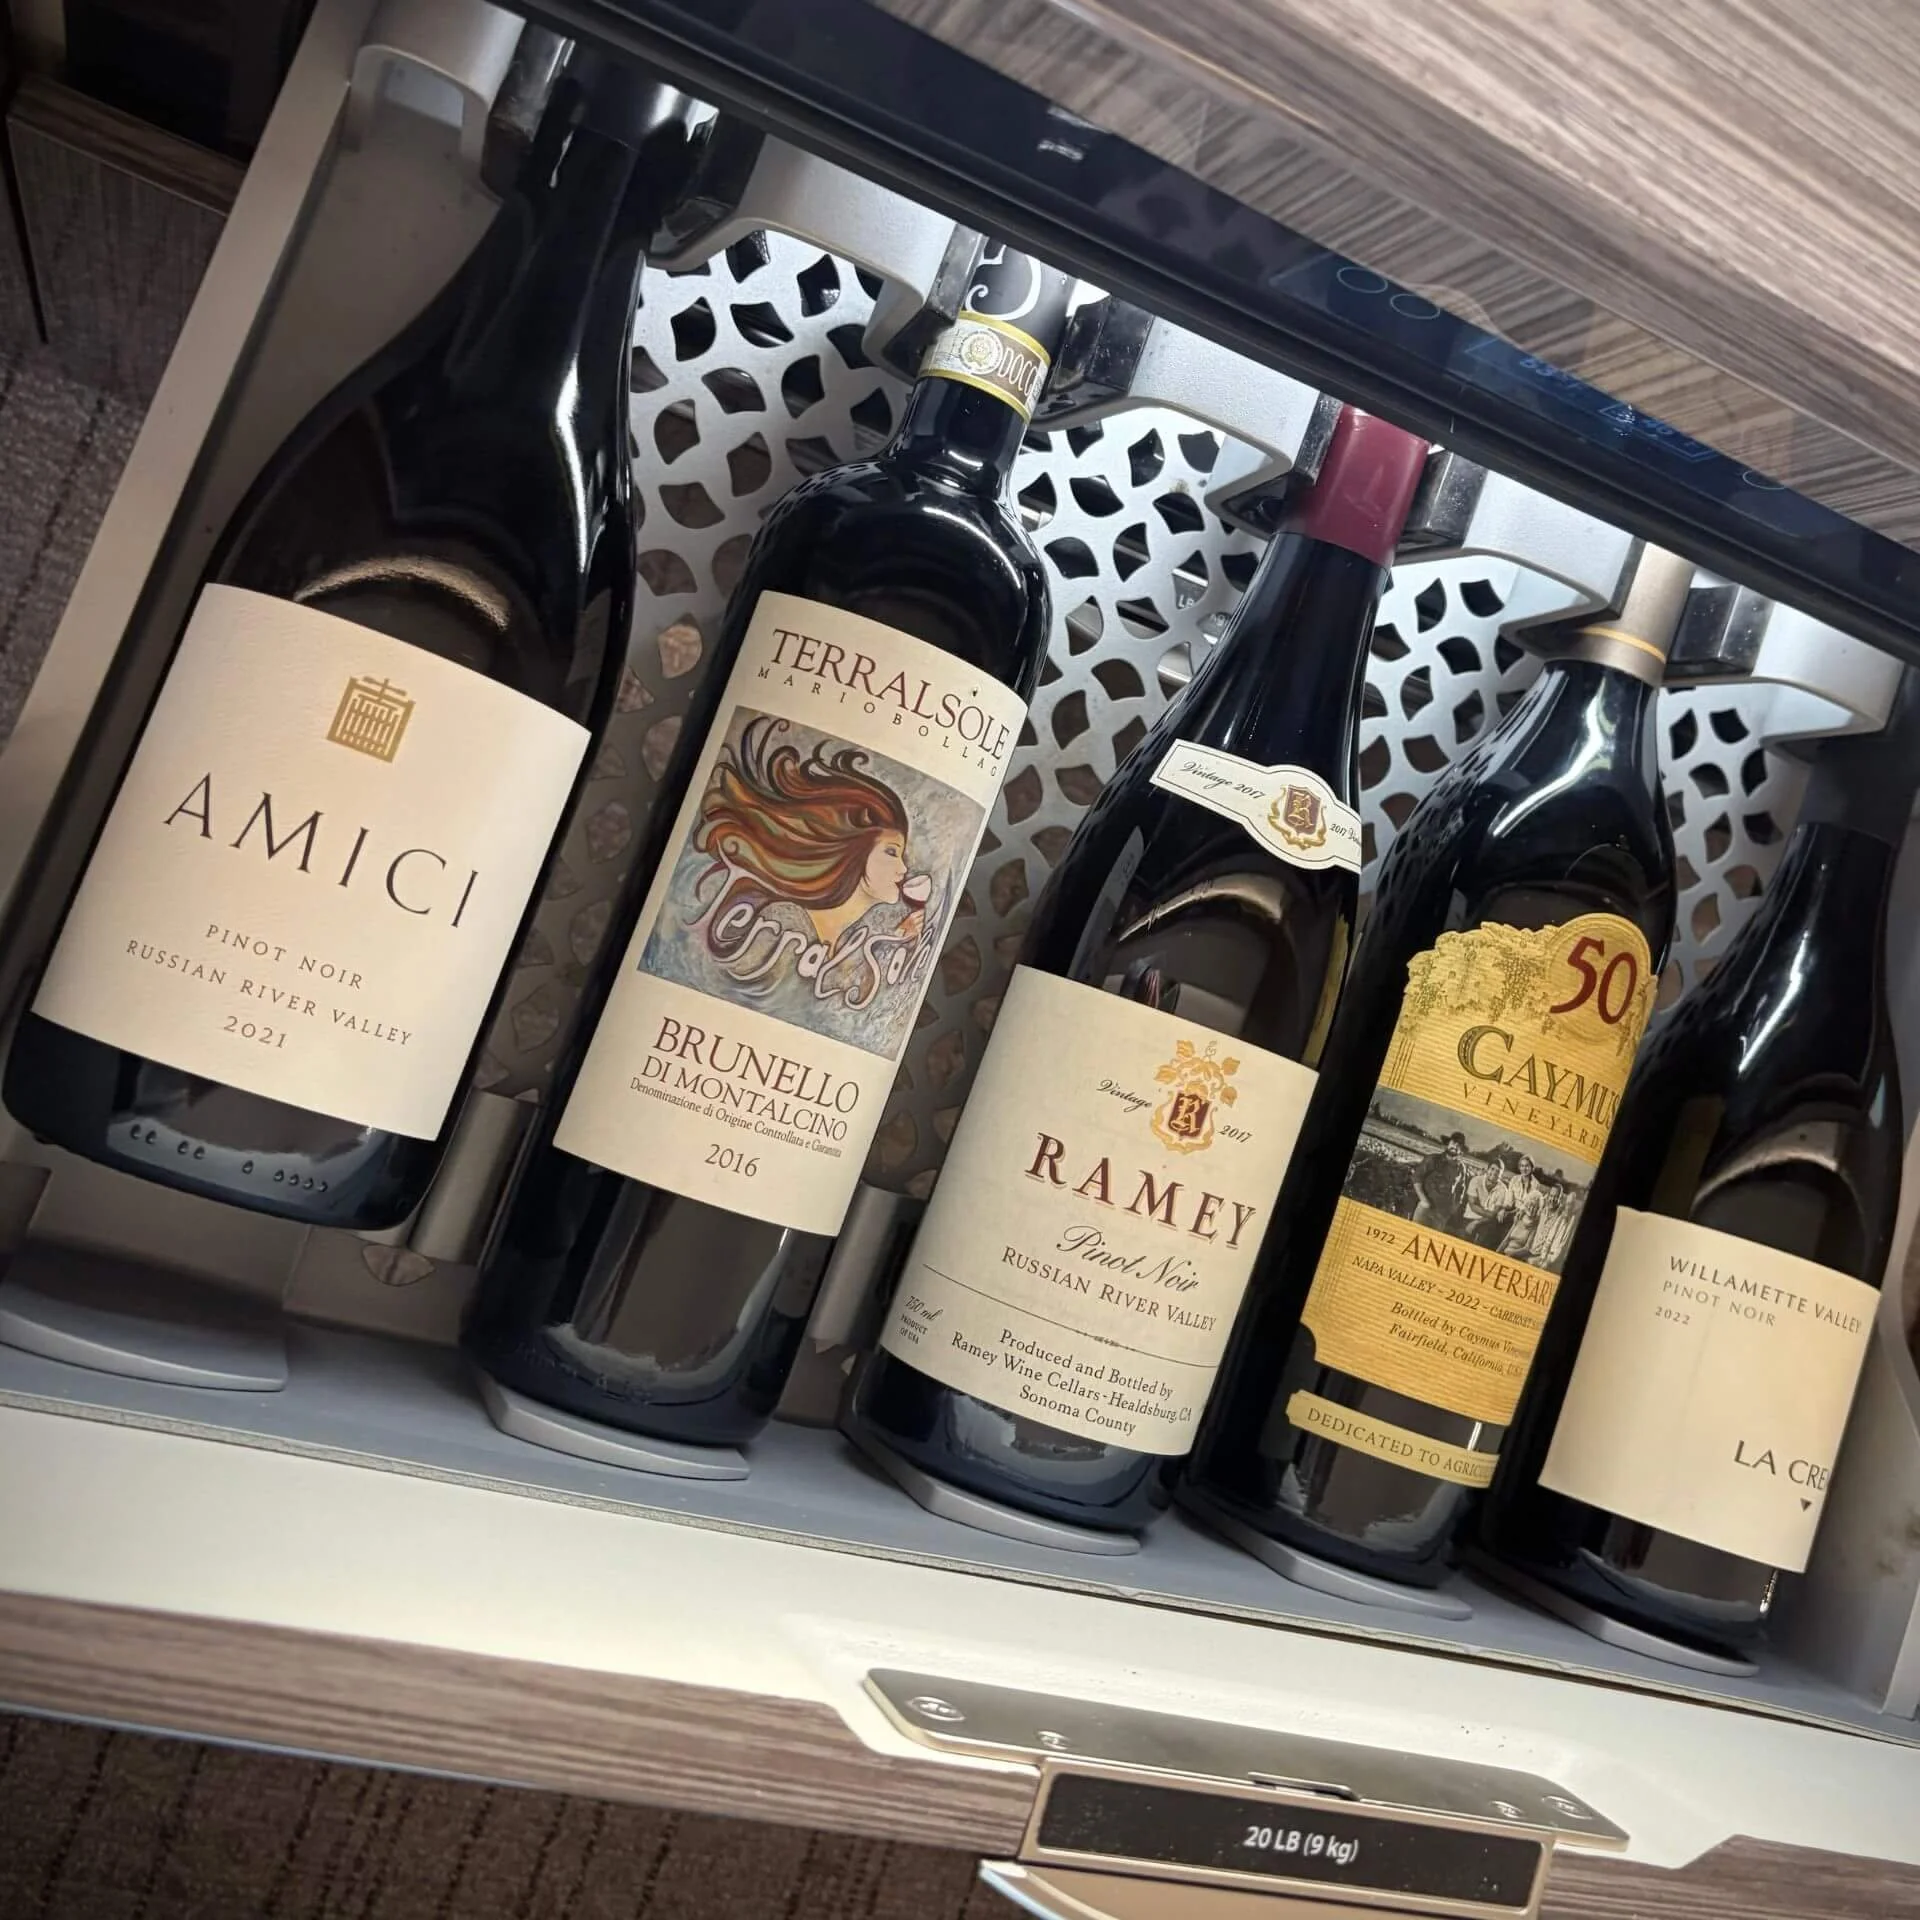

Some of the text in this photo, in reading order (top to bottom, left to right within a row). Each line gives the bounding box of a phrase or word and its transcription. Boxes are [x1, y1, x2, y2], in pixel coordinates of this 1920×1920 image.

[758, 666, 876, 714] MARIO
[770, 629, 1010, 760] TERRALSOLE
[1180, 761, 1266, 799] Vintage 2017
[163, 771, 480, 930] AMICI
[1330, 823, 1347, 837] 2017
[206, 924, 365, 990] PINOT NOIR
[1550, 936, 1637, 1025] 50
[126, 940, 413, 1047] RUSSIAN RIVER VALLEY
[222, 1015, 288, 1050] 2021
[652, 1016, 860, 1113] BRUNELLO
[630, 1077, 701, 1112] Denominazione
[703, 1104, 714, 1118] di
[716, 1108, 752, 1132] Origine
[754, 1120, 804, 1147] Controllata
[641, 1055, 848, 1141] DI MONTALCINO
[1096, 1079, 1253, 1144] Vintage 2017
[1463, 1083, 1602, 1152] VINEYARD
[704, 1143, 761, 1178] 2016
[1024, 1132, 1257, 1249] RAMEY
[1056, 1225, 1199, 1293] Pinot Noir
[1365, 1225, 1396, 1245] 1972
[1001, 1246, 1216, 1332] RUSSIAN RIVER VALLEY
[1352, 1255, 1383, 1277] NAPA
[1388, 1267, 1437, 1293] VALLEY
[1446, 1289, 1481, 1310] 2022
[1663, 1280, 1777, 1327] PINOT NOIR
[1669, 1255, 1862, 1334] WILLAMETTE VALLEY
[1389, 1323, 1448, 1357] Fairfield,
[1391, 1302, 1440, 1329] Bottled
[1443, 1319, 1457, 1338] by
[1459, 1326, 1500, 1349] Caymus
[1655, 1306, 1691, 1326] 2022
[951, 1331, 998, 1366] Ramey
[1003, 1353, 1043, 1382] Wine
[1000, 1329, 1174, 1401] Produced and Bottled by
[1019, 1385, 1137, 1434] Sonoma County
[1307, 1407, 1413, 1457] DEDICATED
[1419, 1448, 1440, 1466] TO
[1733, 1440, 1777, 1476] LA
[1243, 1825, 1359, 1865] 20 LB (9 kg)
